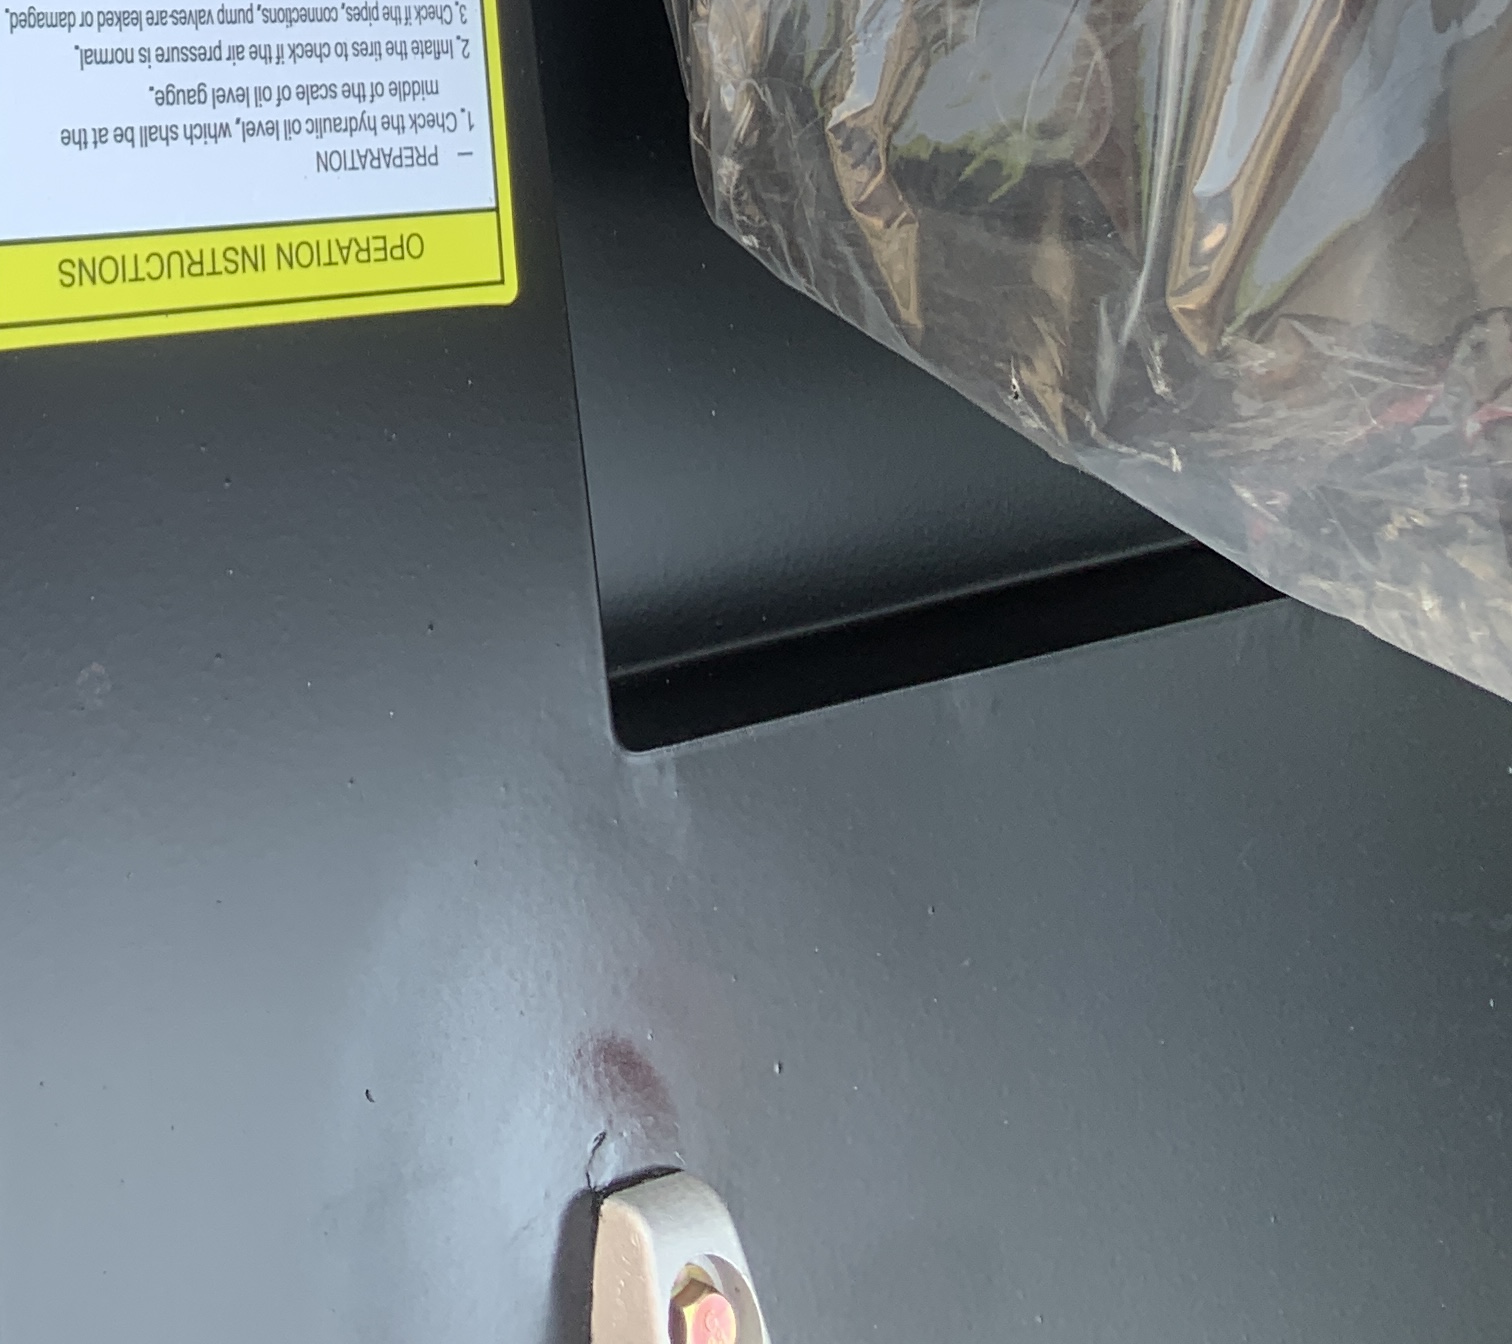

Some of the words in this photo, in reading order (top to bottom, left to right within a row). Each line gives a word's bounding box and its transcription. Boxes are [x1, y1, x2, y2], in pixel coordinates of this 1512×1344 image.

[73, 44, 134, 71] normal.
[137, 46, 151, 69] is
[154, 39, 222, 63] pressure
[224, 43, 245, 66] air
[247, 43, 273, 65] the
[274, 42, 285, 65] if
[286, 41, 331, 64] check
[333, 40, 348, 61] to
[350, 39, 382, 61] tires
[384, 39, 408, 61] the
[410, 38, 453, 60] Inflate
[455, 34, 470, 59] 2.
[147, 81, 207, 107] gauge.
[211, 85, 250, 109] level
[253, 84, 272, 108] oil
[274, 83, 291, 107] of
[294, 82, 337, 105] scale
[340, 81, 366, 104] the
[368, 80, 384, 103] of
[387, 78, 439, 102] middle
[234, 116, 279, 142] level,
[282, 117, 302, 141] oil
[304, 109, 377, 139] hydraulic
[380, 113, 406, 135] the
[407, 110, 457, 134] Check
[459, 107, 474, 131] 1.
[60, 127, 88, 151] the
[90, 126, 109, 149] at
[112, 125, 135, 148] be
[138, 123, 179, 148] shall
[182, 121, 232, 145] which
[315, 143, 438, 173] PREPARATION
[275, 232, 424, 270] OPERATION
[57, 243, 265, 288] INSTRUCTIONS
